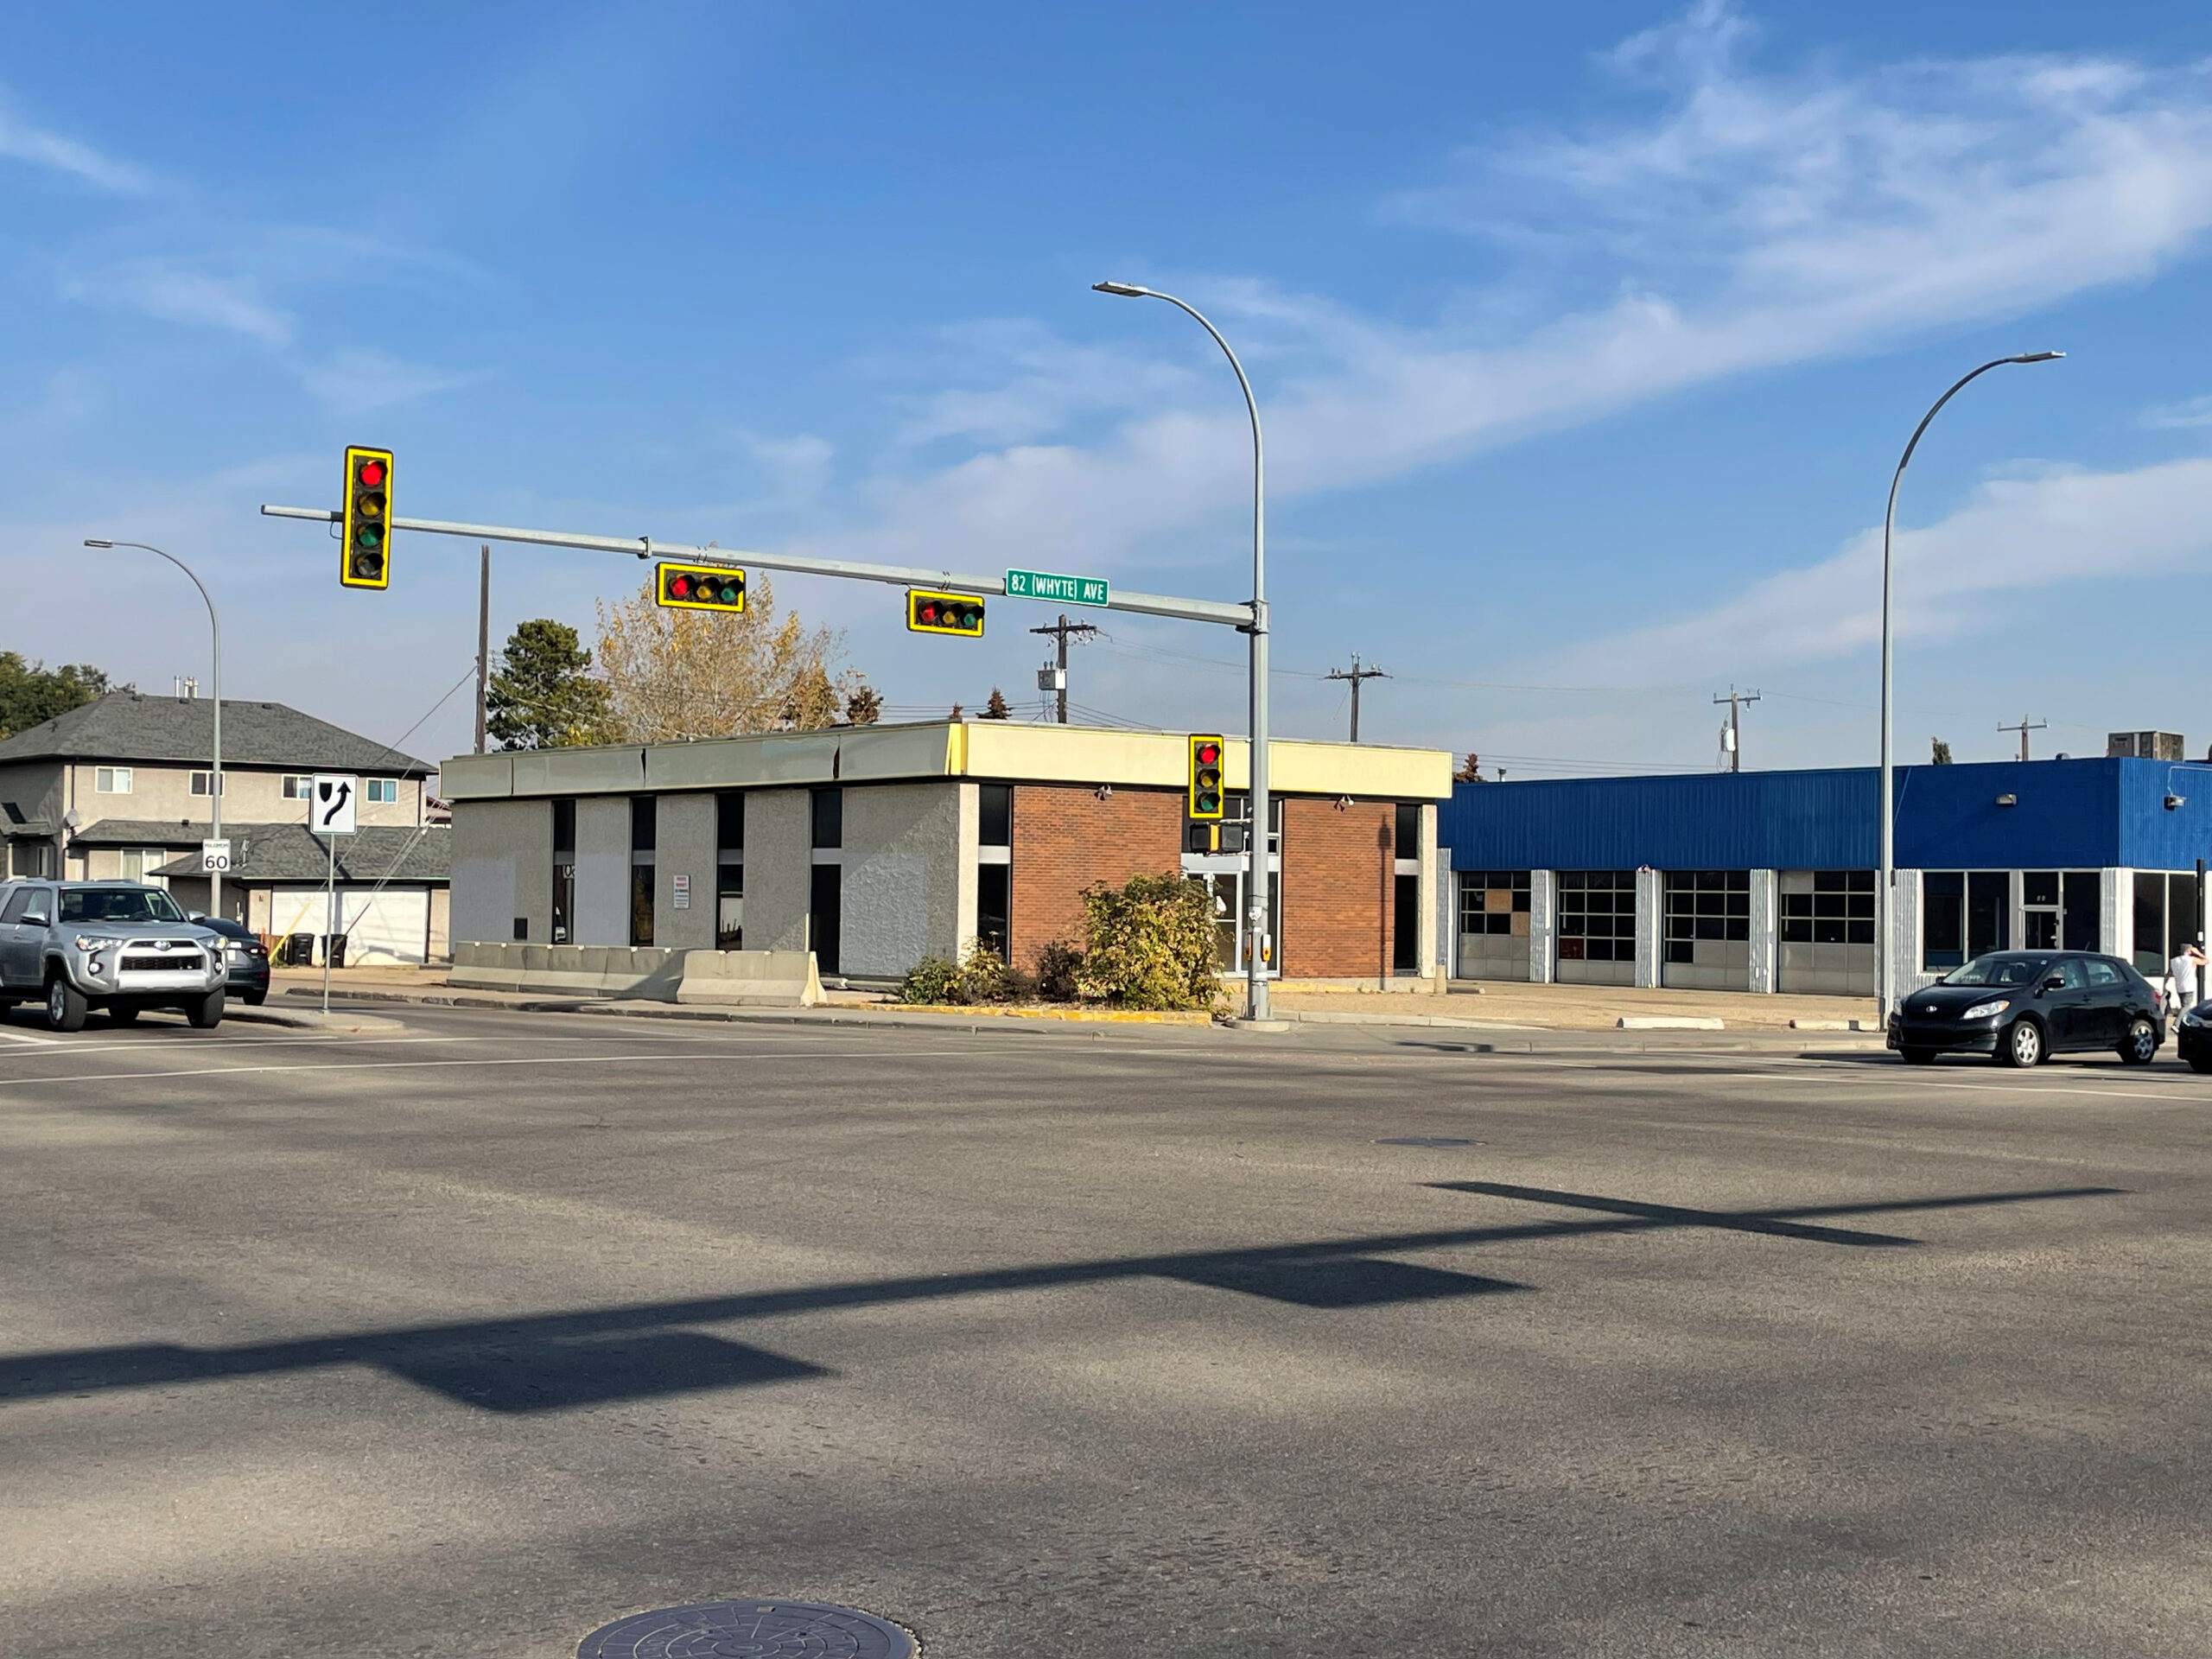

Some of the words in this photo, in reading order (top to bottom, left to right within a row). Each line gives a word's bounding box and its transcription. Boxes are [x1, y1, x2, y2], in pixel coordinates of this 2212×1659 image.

[1012, 574, 1026, 592] 82
[1032, 574, 1077, 601] (WHYTE)
[1084, 582, 1104, 601] AVE
[205, 855, 227, 869] 60
